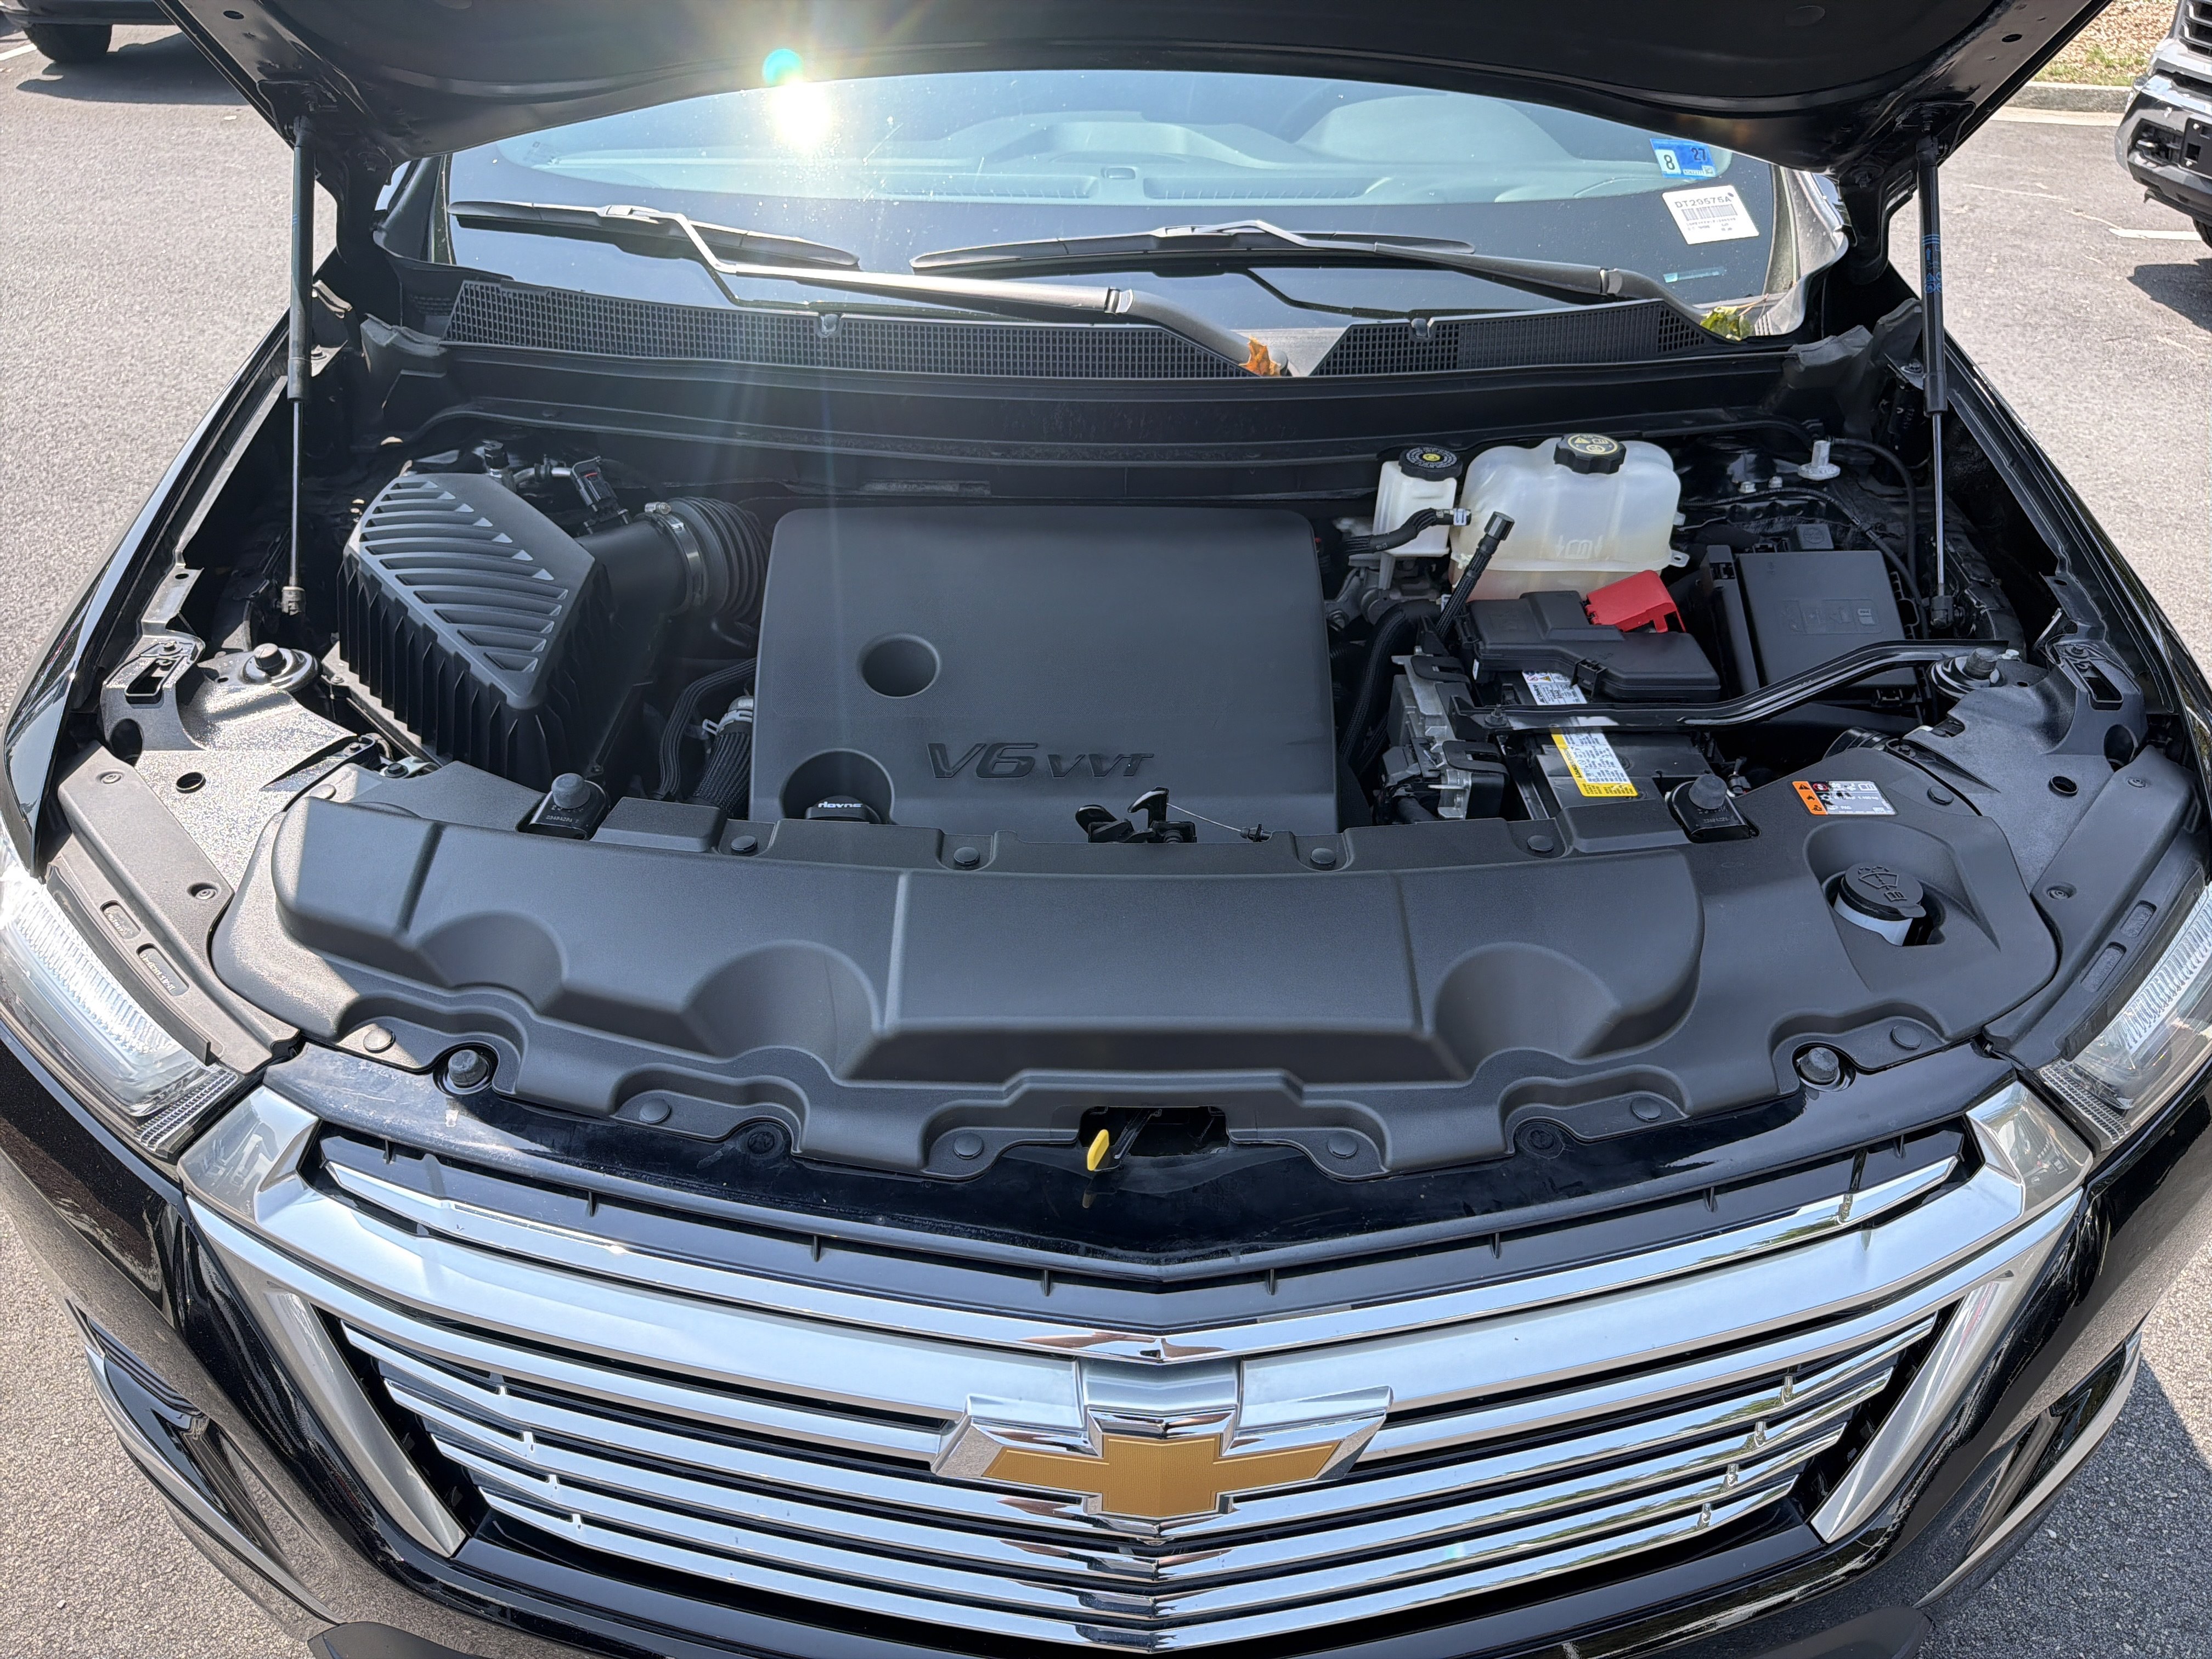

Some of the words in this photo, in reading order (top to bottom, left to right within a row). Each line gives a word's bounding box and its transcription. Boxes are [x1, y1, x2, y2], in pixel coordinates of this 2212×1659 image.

[1663, 154, 1675, 171] 8
[1691, 147, 1706, 161] 27
[927, 742, 1039, 778] V6
[1047, 753, 1154, 777] VVT
